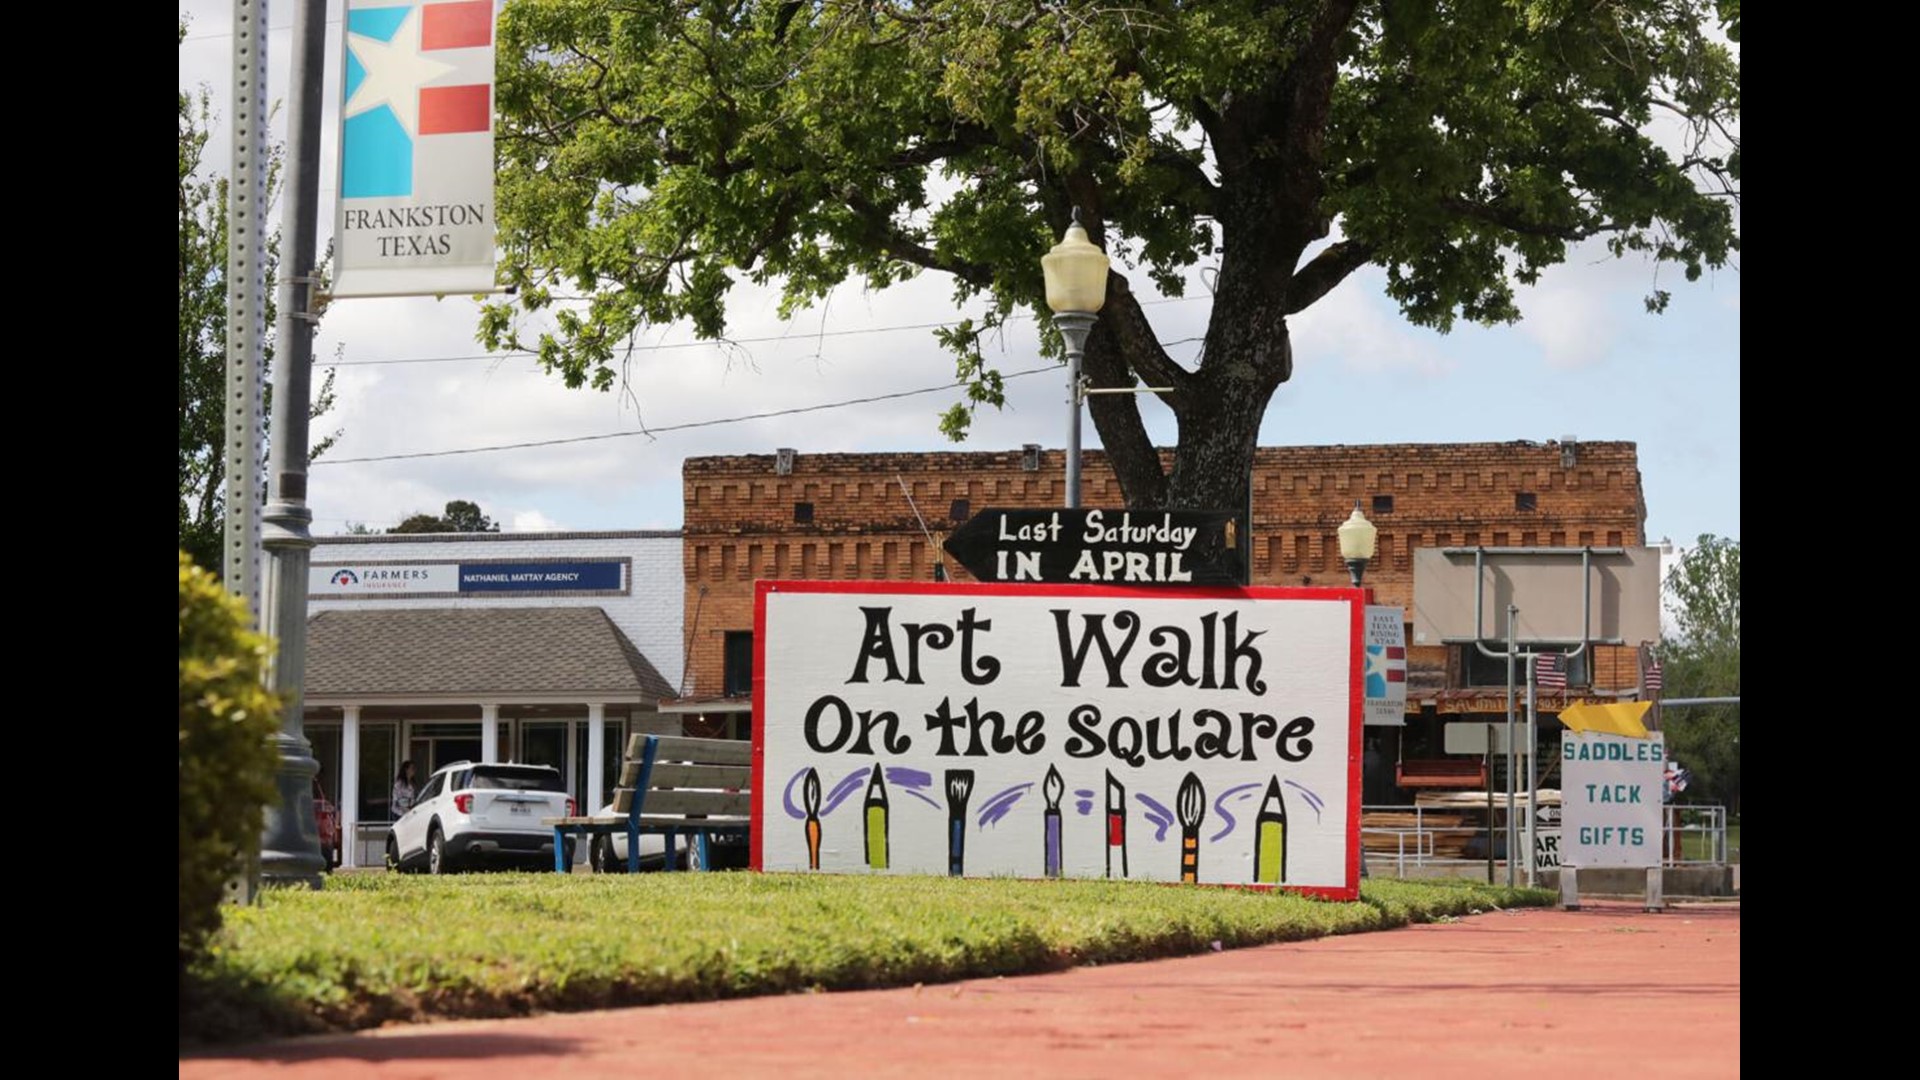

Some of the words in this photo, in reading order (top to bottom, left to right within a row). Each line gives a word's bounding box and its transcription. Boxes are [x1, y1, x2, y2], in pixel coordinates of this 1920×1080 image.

[343, 203, 485, 231] FRANKSTON
[376, 233, 451, 257] TEXAS
[999, 512, 1063, 542] Last
[1083, 509, 1197, 550] Saturday
[363, 570, 429, 580] FARMERS
[996, 550, 1043, 580] IN
[1068, 549, 1192, 582] APRIL
[463, 573, 509, 583] NATHANIEL
[510, 572, 544, 582] MATTAY
[544, 572, 580, 582] AGENCY
[845, 606, 1001, 685] Art
[1049, 608, 1268, 696] Walk
[804, 695, 911, 755] On
[925, 696, 1046, 757] the
[1563, 742, 1662, 761] SADDLES
[1585, 785, 1641, 803] TACK
[1536, 836, 1561, 852] AR
[1580, 827, 1644, 845] GIFTS
